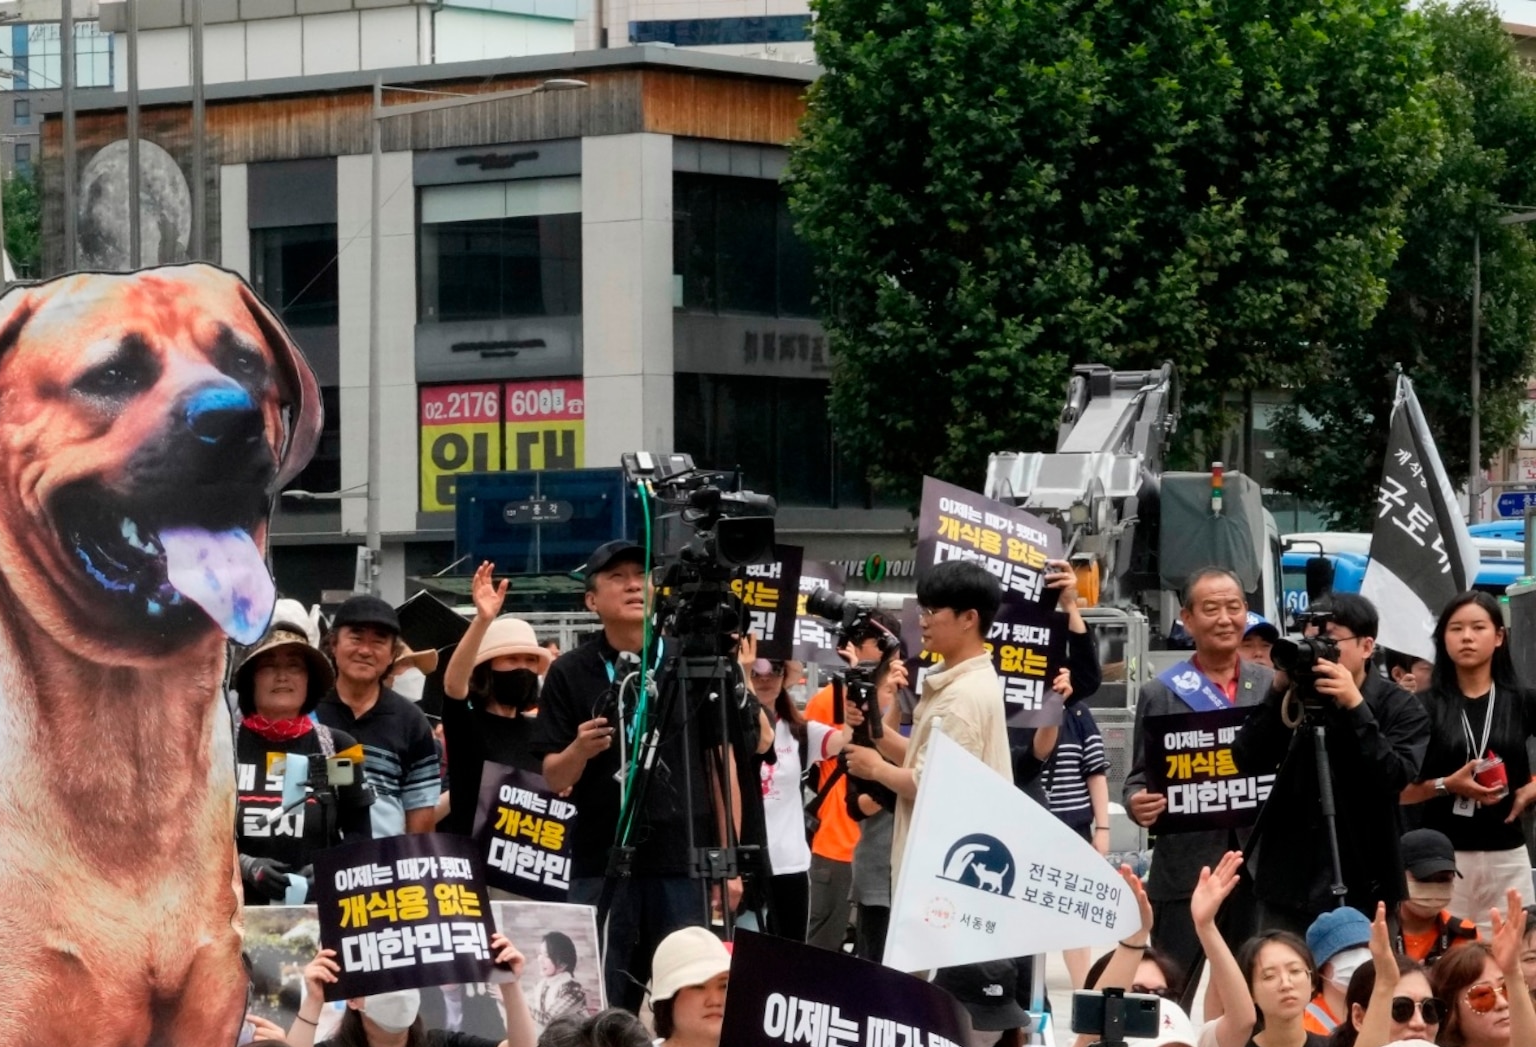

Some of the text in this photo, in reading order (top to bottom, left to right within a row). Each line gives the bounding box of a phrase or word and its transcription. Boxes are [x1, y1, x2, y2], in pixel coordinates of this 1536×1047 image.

[937, 516, 1047, 569] 개식용 없는
[940, 497, 1048, 547] 이제는 때가 됐다!
[934, 541, 1044, 602] 대민국!
[1012, 624, 1050, 645] 됐다!
[1000, 644, 1047, 676] 없는
[1164, 729, 1214, 750] 이제는
[499, 784, 547, 814] 이제는
[495, 806, 565, 850] 개식용
[335, 856, 473, 891] 이제는 때가 됐다!
[487, 837, 571, 890] 대한민
[1028, 861, 1122, 907] 전국길고양이
[338, 883, 482, 928] 개식용 없는
[960, 913, 996, 934] 서동행
[1022, 886, 1118, 929] 보호단체연합
[342, 922, 490, 972] 대한민국!
